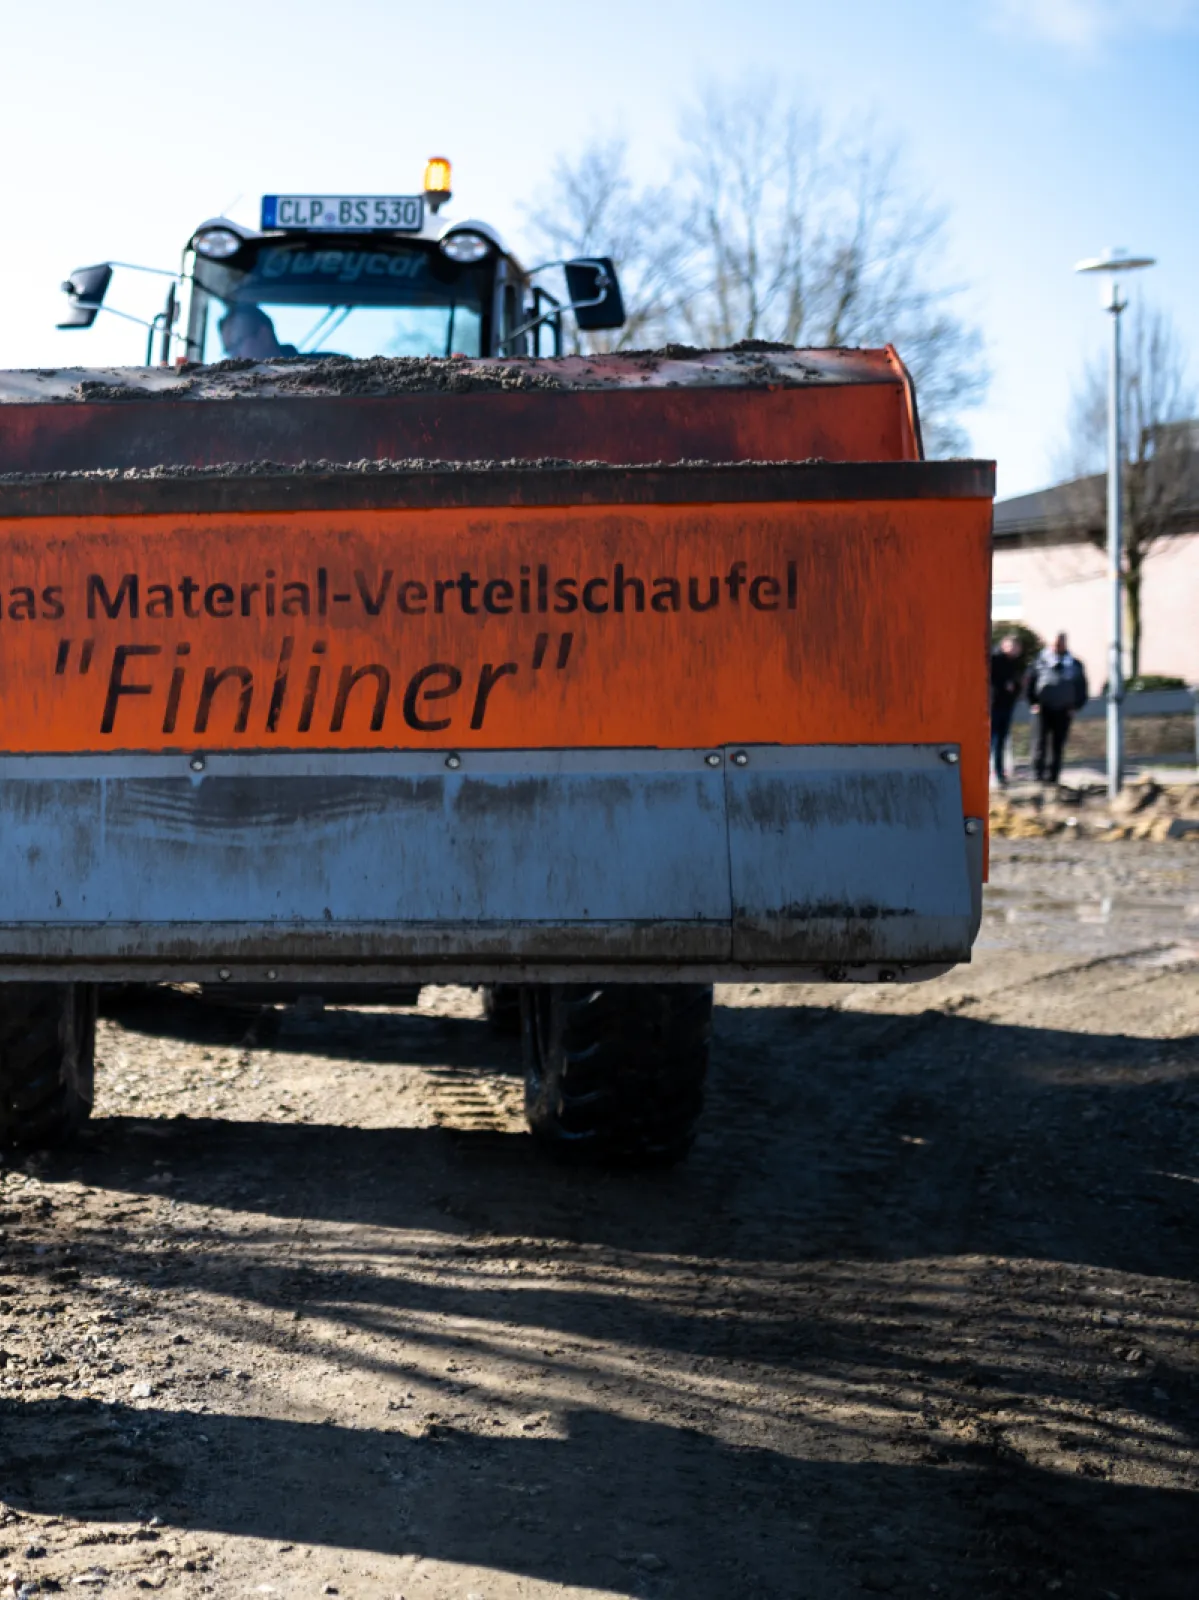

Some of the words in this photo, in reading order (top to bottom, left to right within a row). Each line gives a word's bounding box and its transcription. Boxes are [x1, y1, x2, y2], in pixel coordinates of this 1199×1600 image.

[279, 200, 324, 226] CLP
[338, 200, 369, 225] BS
[373, 200, 417, 225] 530
[87, 560, 798, 619] Material-Verteilschaufel
[55, 631, 574, 734] "Finliner"
